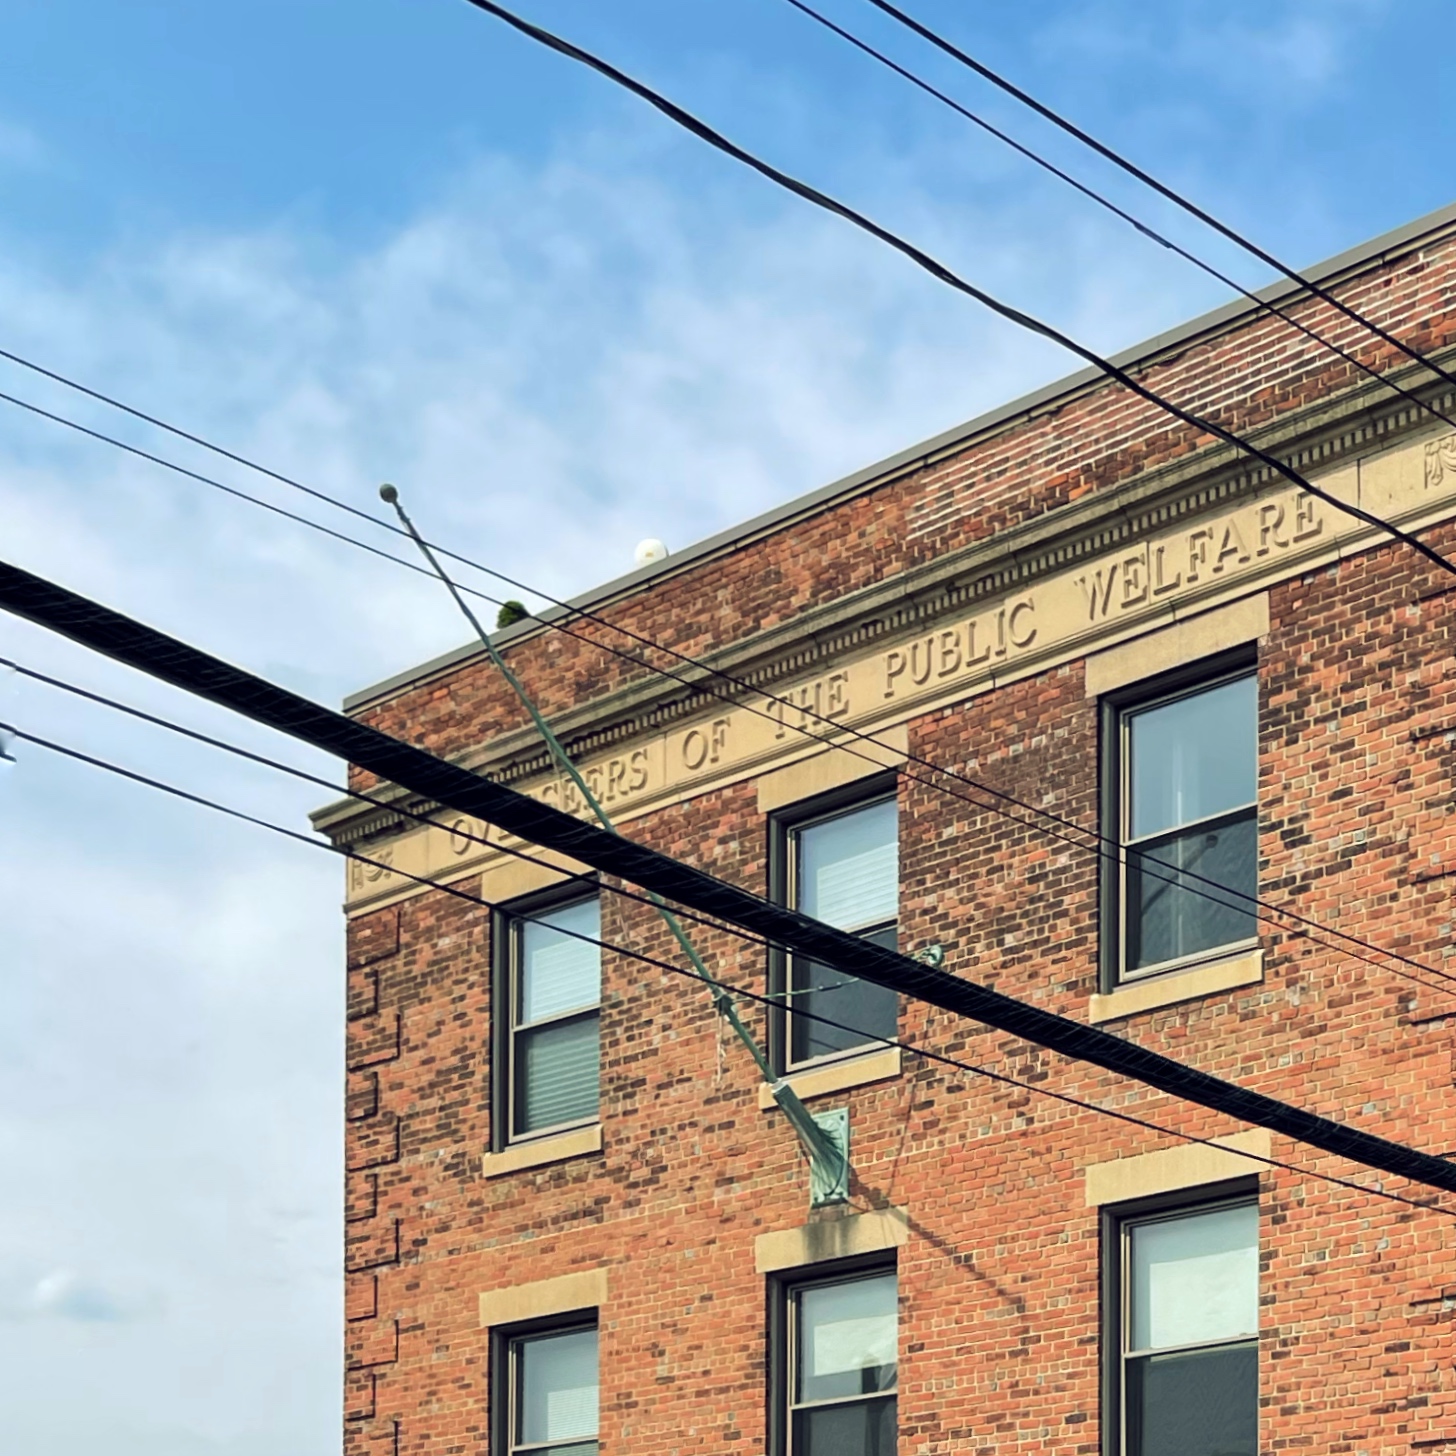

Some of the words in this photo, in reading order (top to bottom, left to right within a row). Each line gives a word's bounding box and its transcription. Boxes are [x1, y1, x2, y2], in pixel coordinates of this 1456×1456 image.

[450, 748, 649, 856] OVSEERS
[681, 716, 732, 771] OF
[767, 669, 850, 740] THE
[884, 597, 1038, 698] PUBLIC
[1073, 486, 1324, 621] WELFARE
